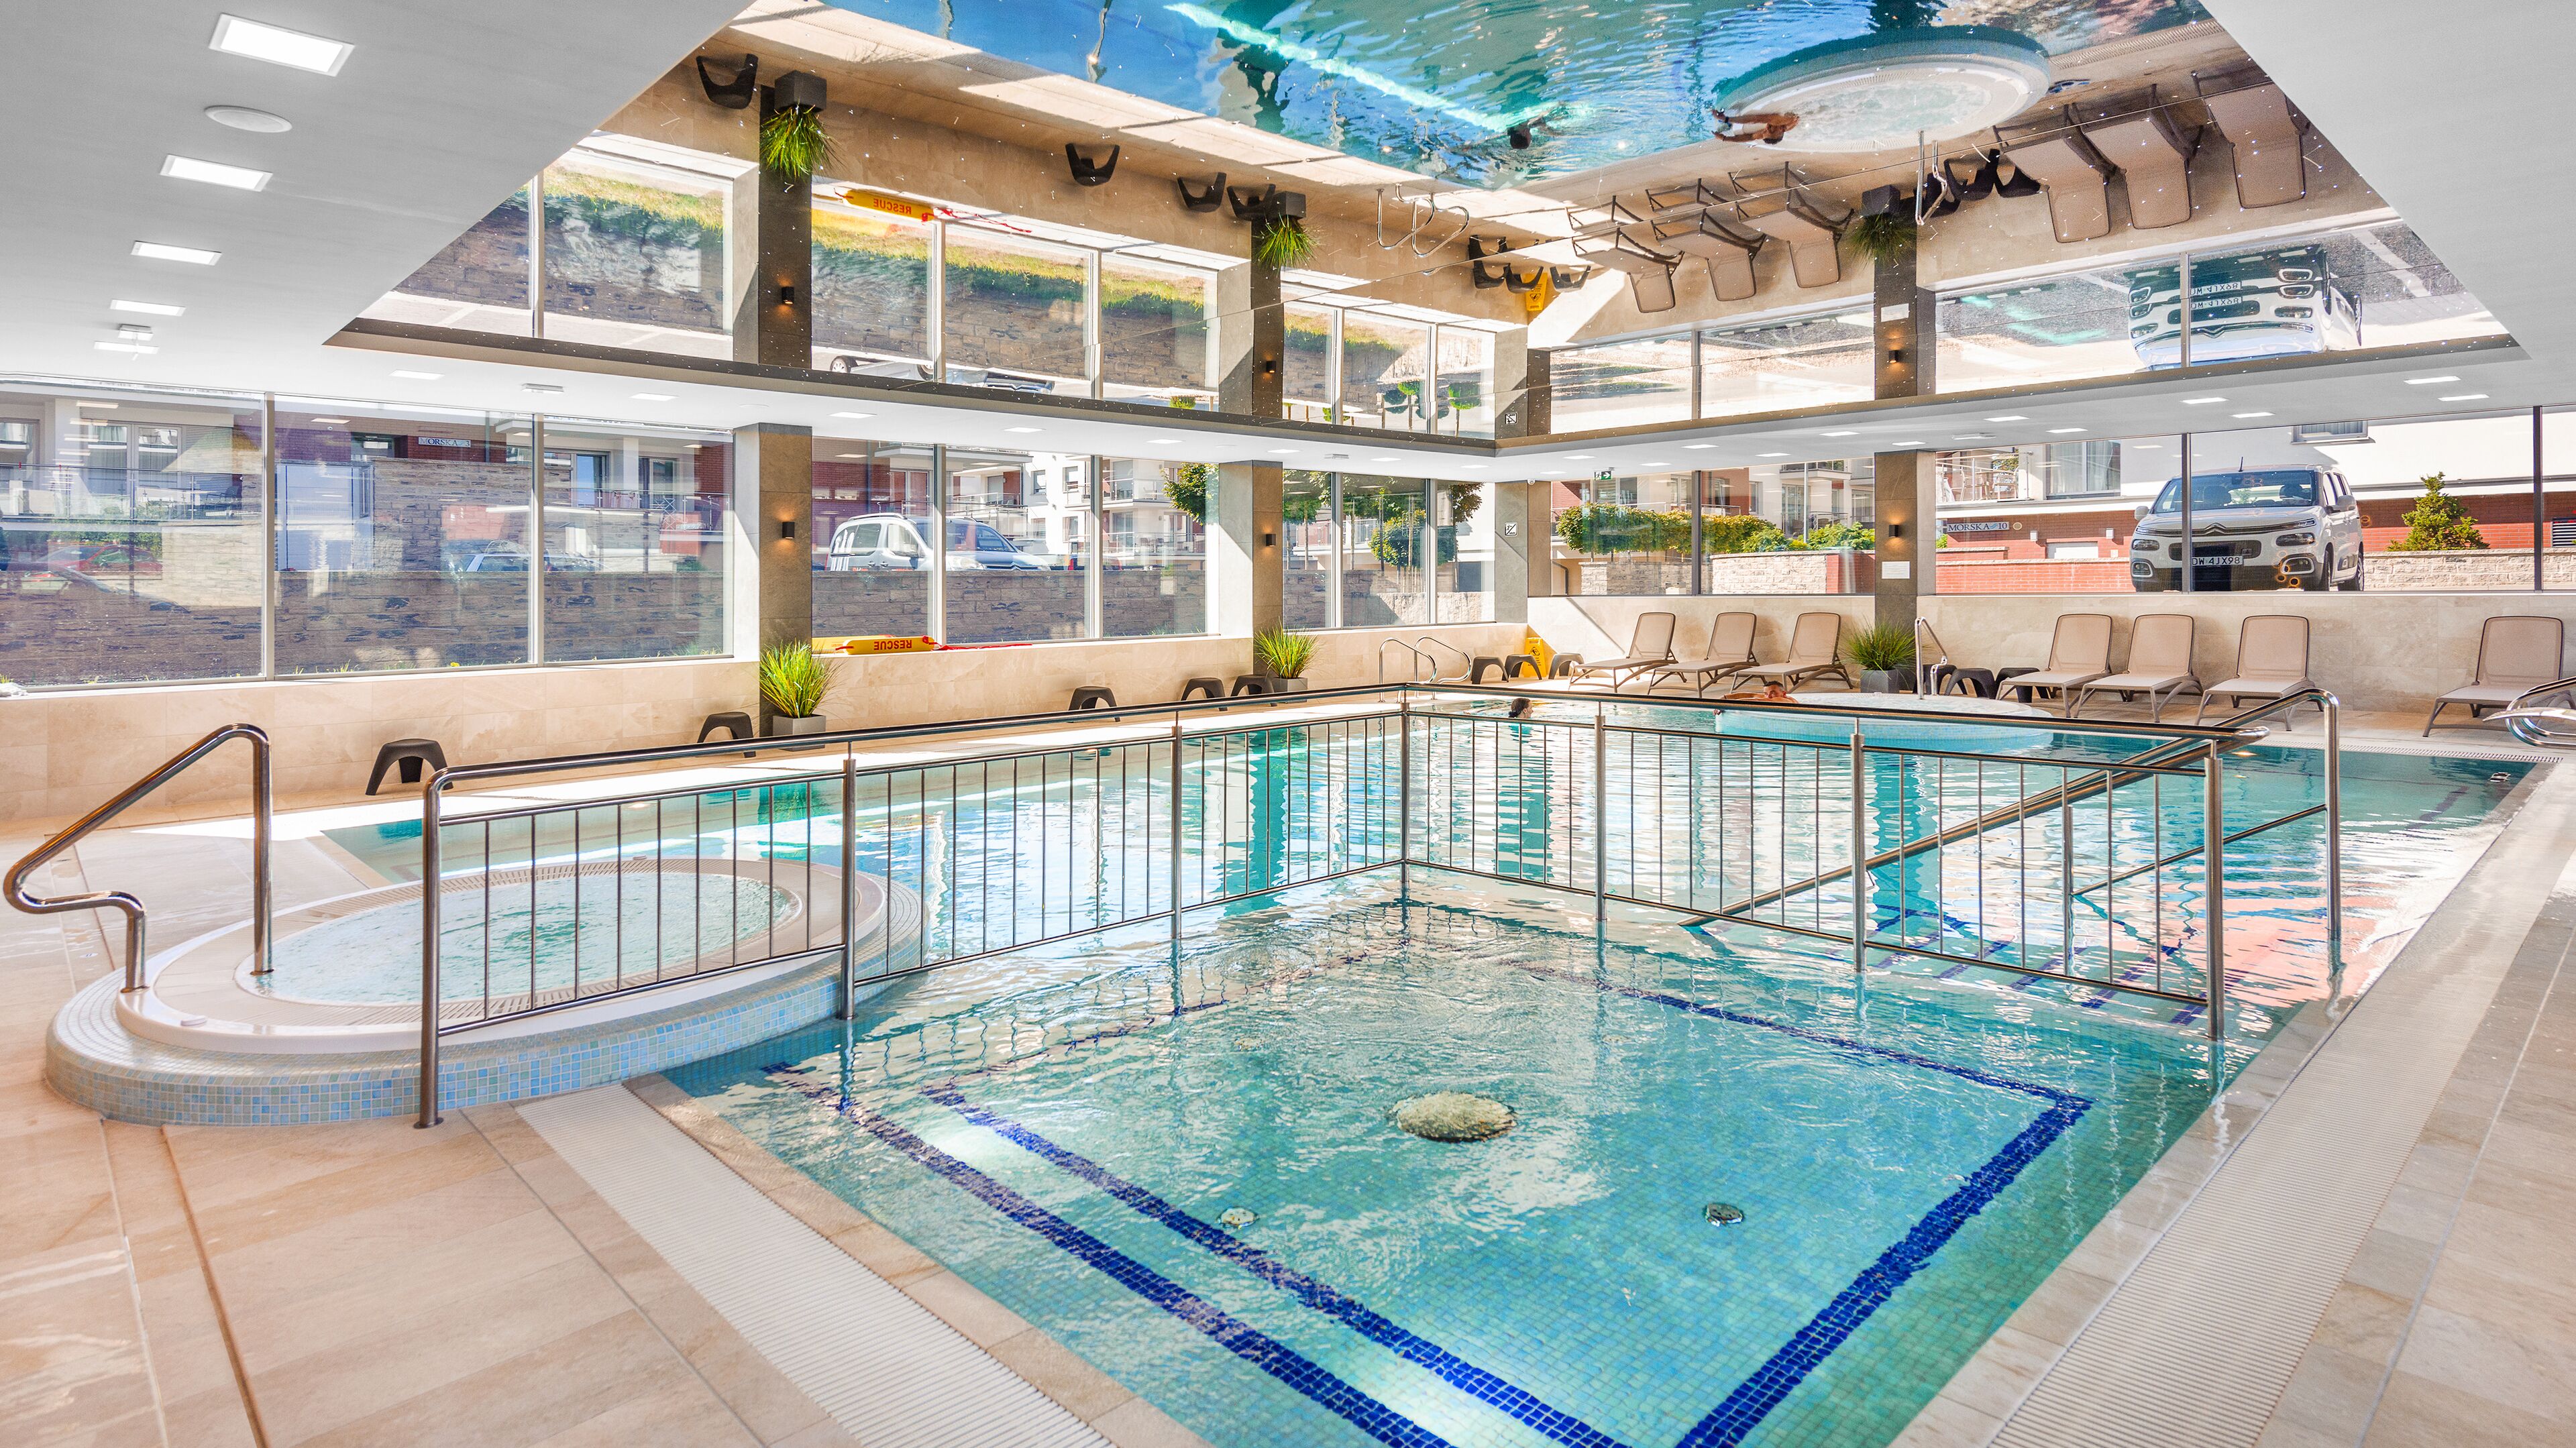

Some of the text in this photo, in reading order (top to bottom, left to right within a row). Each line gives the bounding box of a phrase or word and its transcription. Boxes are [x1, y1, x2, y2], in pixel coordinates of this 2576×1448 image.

[419, 438, 458, 446] MORSKA
[1948, 523, 1990, 531] MORSKA
[2208, 557, 2240, 565] 4JX98
[873, 639, 912, 651] RESCUE
